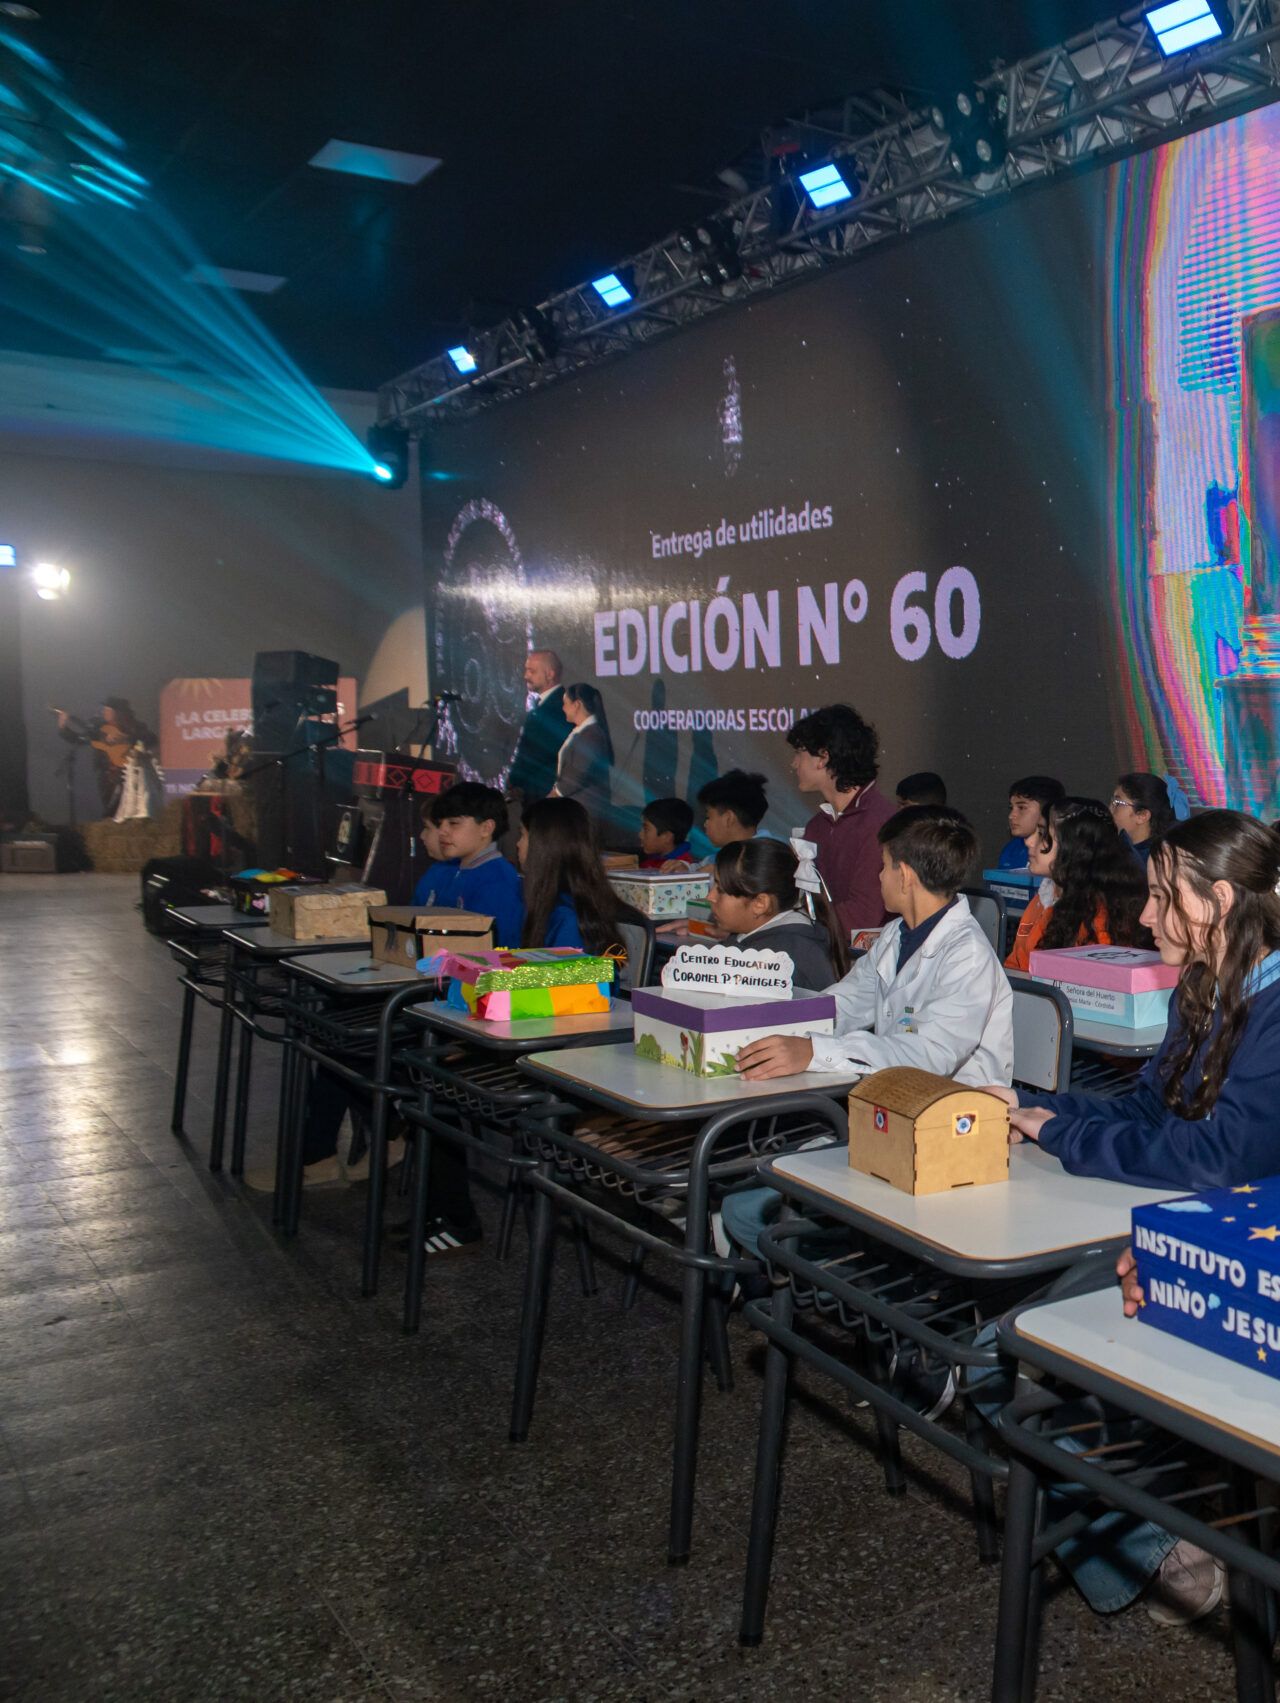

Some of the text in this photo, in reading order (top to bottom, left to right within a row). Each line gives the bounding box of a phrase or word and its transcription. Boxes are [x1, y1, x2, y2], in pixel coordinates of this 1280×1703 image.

[652, 501, 832, 558] Entrega de utilidades
[594, 576, 781, 677] EDICIÓN
[890, 566, 981, 661] 60
[634, 709, 745, 731] COOPERADORAS
[673, 968, 719, 985] CORONEL
[681, 951, 780, 971] CENTRO EDUCATIVO
[1067, 986, 1116, 1001] Señora del Huerto
[1136, 1225, 1246, 1288] INSTITUTO
[1149, 1278, 1206, 1319] NIÑO
